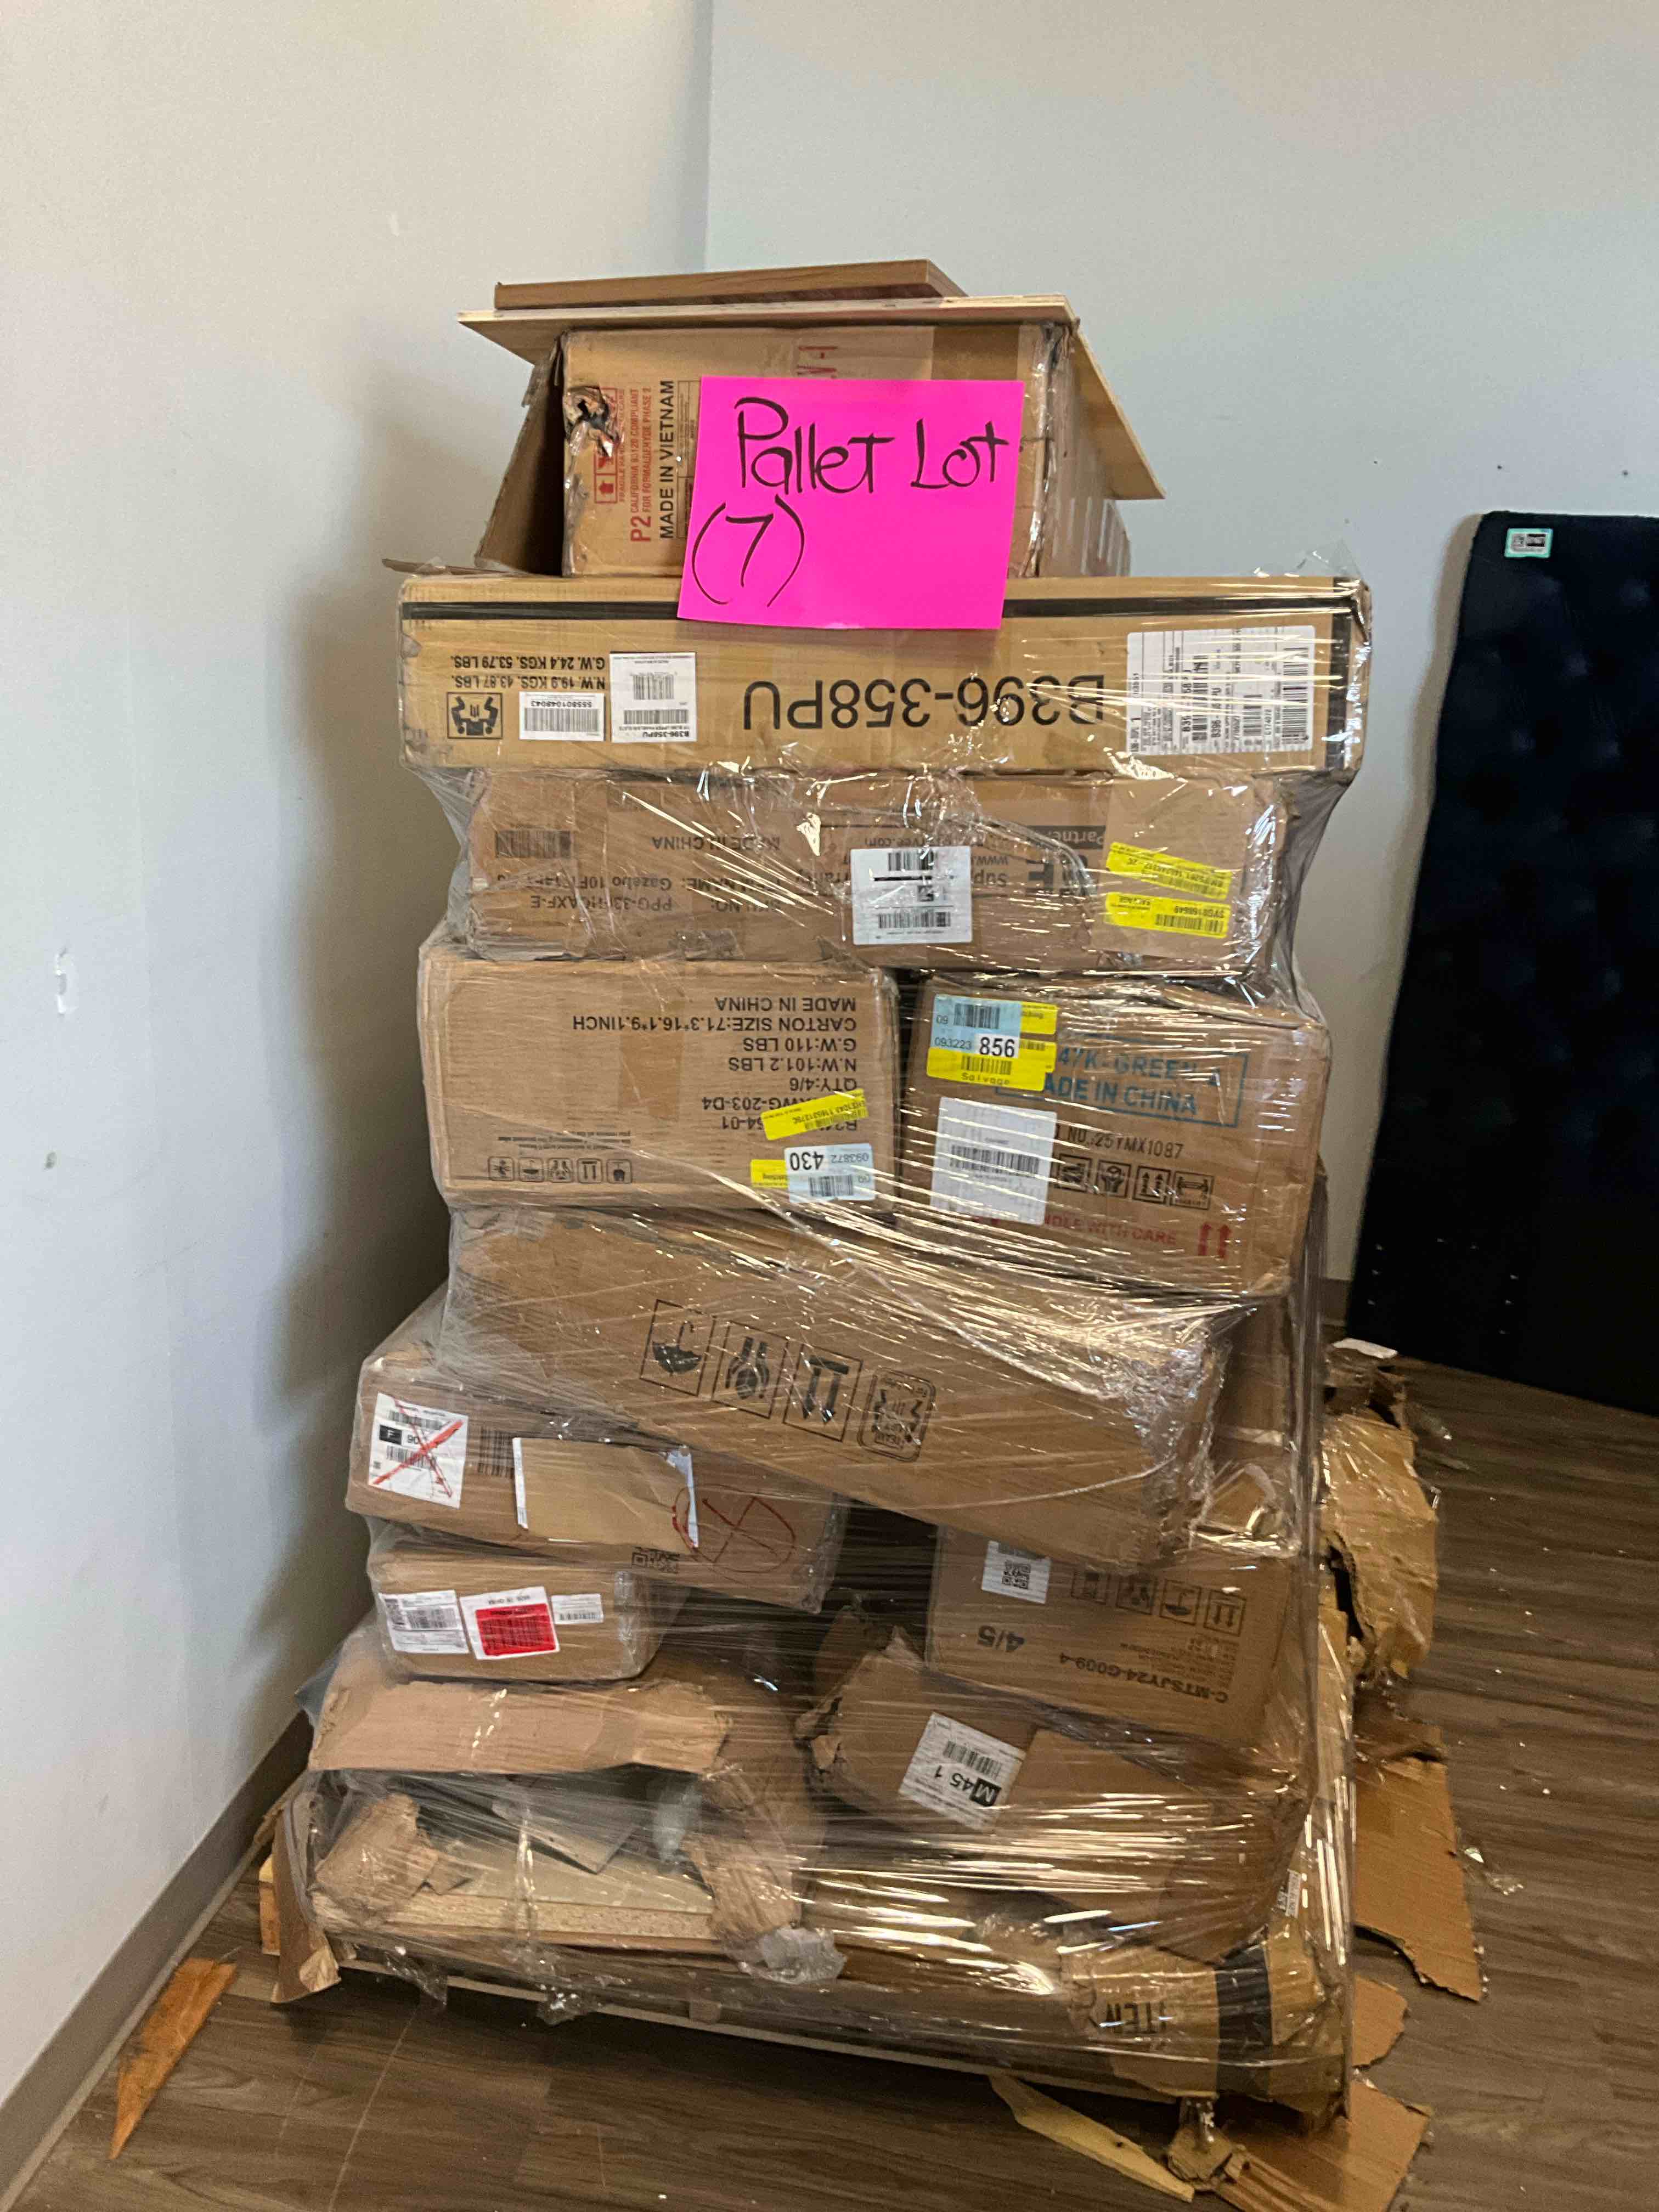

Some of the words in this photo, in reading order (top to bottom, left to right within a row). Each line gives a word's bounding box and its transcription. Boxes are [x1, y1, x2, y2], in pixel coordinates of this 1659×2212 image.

[642, 396, 651, 422] PHASE
[660, 381, 673, 460] VIETNAM
[734, 396, 895, 495] Pallet
[911, 417, 1009, 489] Lot
[642, 425, 651, 493] FORMALDEHYDE
[660, 466, 673, 482] IN
[642, 496, 651, 512] FOR
[660, 489, 673, 538] MADE
[631, 516, 651, 542] P2
[691, 495, 805, 607] (7)
[450, 656, 479, 670] LBS.
[482, 656, 512, 670] 53.79
[517, 656, 547, 670] KGS.
[550, 656, 574, 670] 24.4
[579, 656, 605, 670] G.W.
[451, 676, 479, 689] LBS.
[518, 676, 547, 689] KGS.
[579, 676, 605, 689] N.W.
[743, 675, 1105, 730] B396-358PU
[612, 876, 672, 890] Gazebo
[716, 997, 772, 1012] CHINA
[778, 997, 797, 1012] IN
[804, 997, 856, 1012] MADE
[779, 1017, 856, 1031] CARTON
[743, 1037, 778, 1052] LBS
[786, 1037, 856, 1052] G.W:110
[934, 1036, 972, 1050] 093223
[979, 1036, 1015, 1059] 856
[729, 1058, 764, 1071] LBS
[772, 1058, 856, 1071] N.W:101.2
[789, 1077, 856, 1092] QTY:4/6
[960, 1071, 1011, 1087] Salvage
[1043, 1072, 1091, 1098] ADE
[1097, 1075, 1118, 1102] IN
[1123, 1079, 1199, 1115] CHINA
[789, 1150, 824, 1171] 430
[978, 1624, 1026, 1653] 4/5
